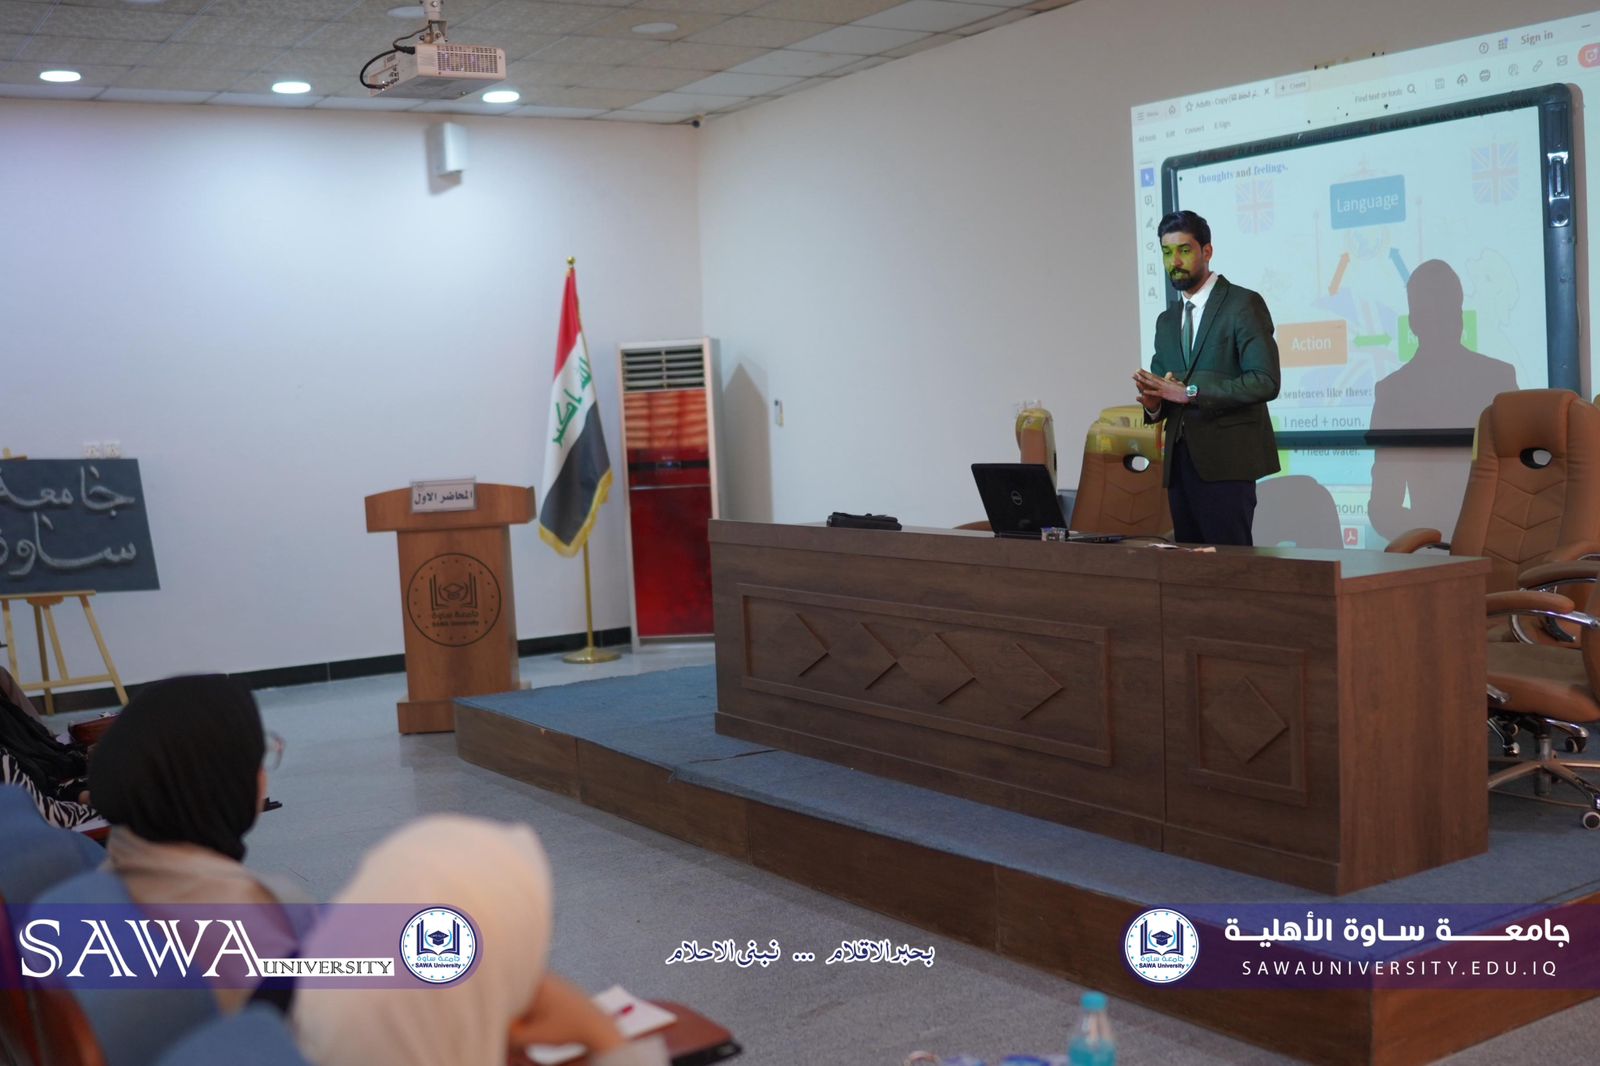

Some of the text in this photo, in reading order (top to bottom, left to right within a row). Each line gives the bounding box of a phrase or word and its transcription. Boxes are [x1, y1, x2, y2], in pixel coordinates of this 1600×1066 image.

[1520, 30, 1554, 47] Sign in
[1198, 162, 1289, 184] thoughts and feelings.
[1336, 190, 1399, 216] Language
[1291, 337, 1332, 351] Action
[1284, 389, 1324, 400] sentences
[1326, 387, 1343, 399] like
[1290, 414, 1318, 428] need
[1331, 415, 1365, 428] noun.
[414, 489, 474, 506] المحاضر الاول
